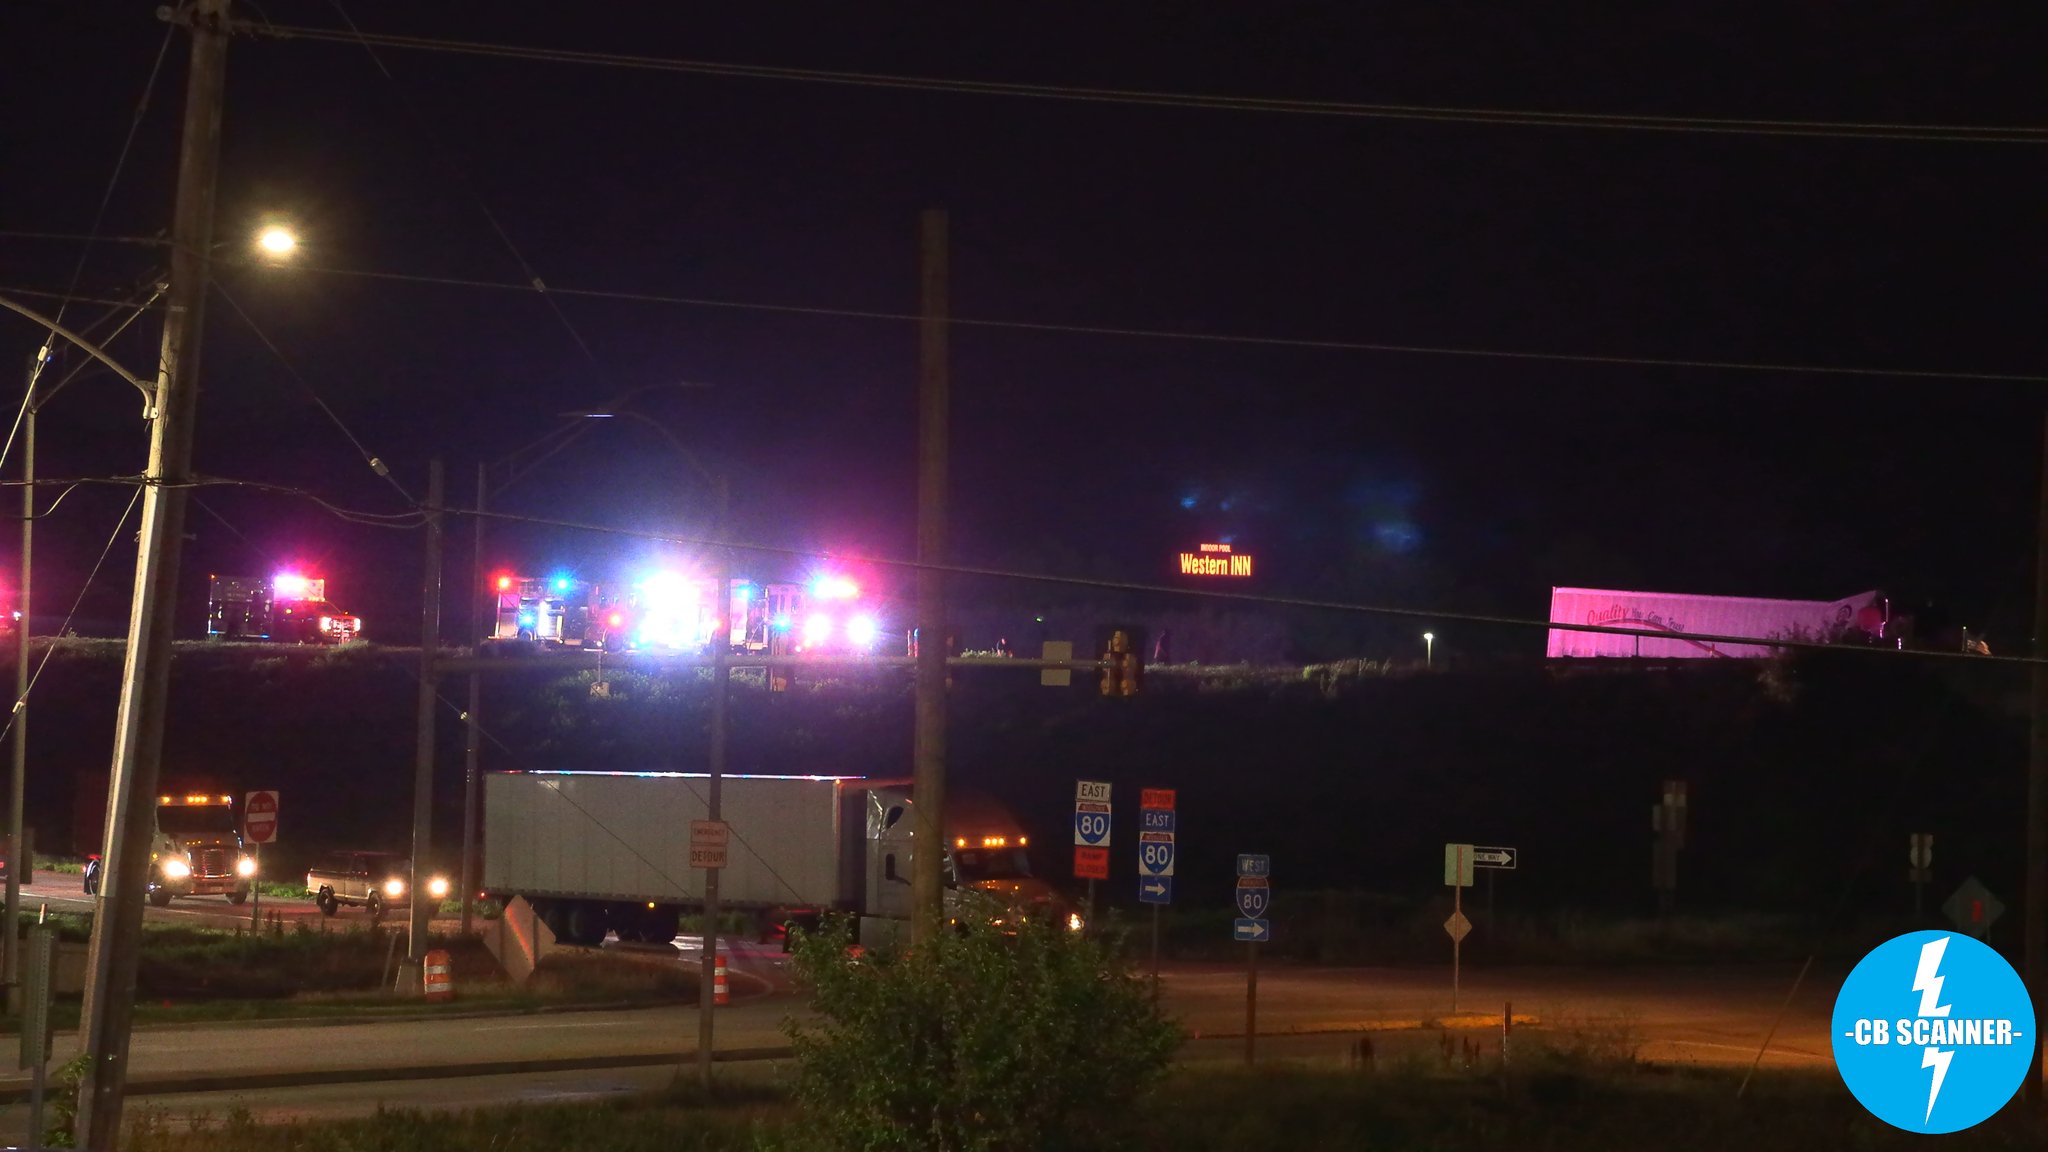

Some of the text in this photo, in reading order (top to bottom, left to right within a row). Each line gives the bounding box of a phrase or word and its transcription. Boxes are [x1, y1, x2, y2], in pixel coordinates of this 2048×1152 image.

[1219, 544, 1231, 553] POOL
[1180, 553, 1251, 576] Western INN
[1587, 604, 1629, 624] Quality
[1648, 611, 1661, 623] Can
[1081, 783, 1105, 798] EAST
[1081, 816, 1105, 836] 80
[1146, 814, 1169, 827] EAST
[692, 851, 725, 863] DETOUR
[1145, 845, 1168, 865] 80
[1241, 859, 1265, 872] WEST
[1243, 894, 1262, 910] 80
